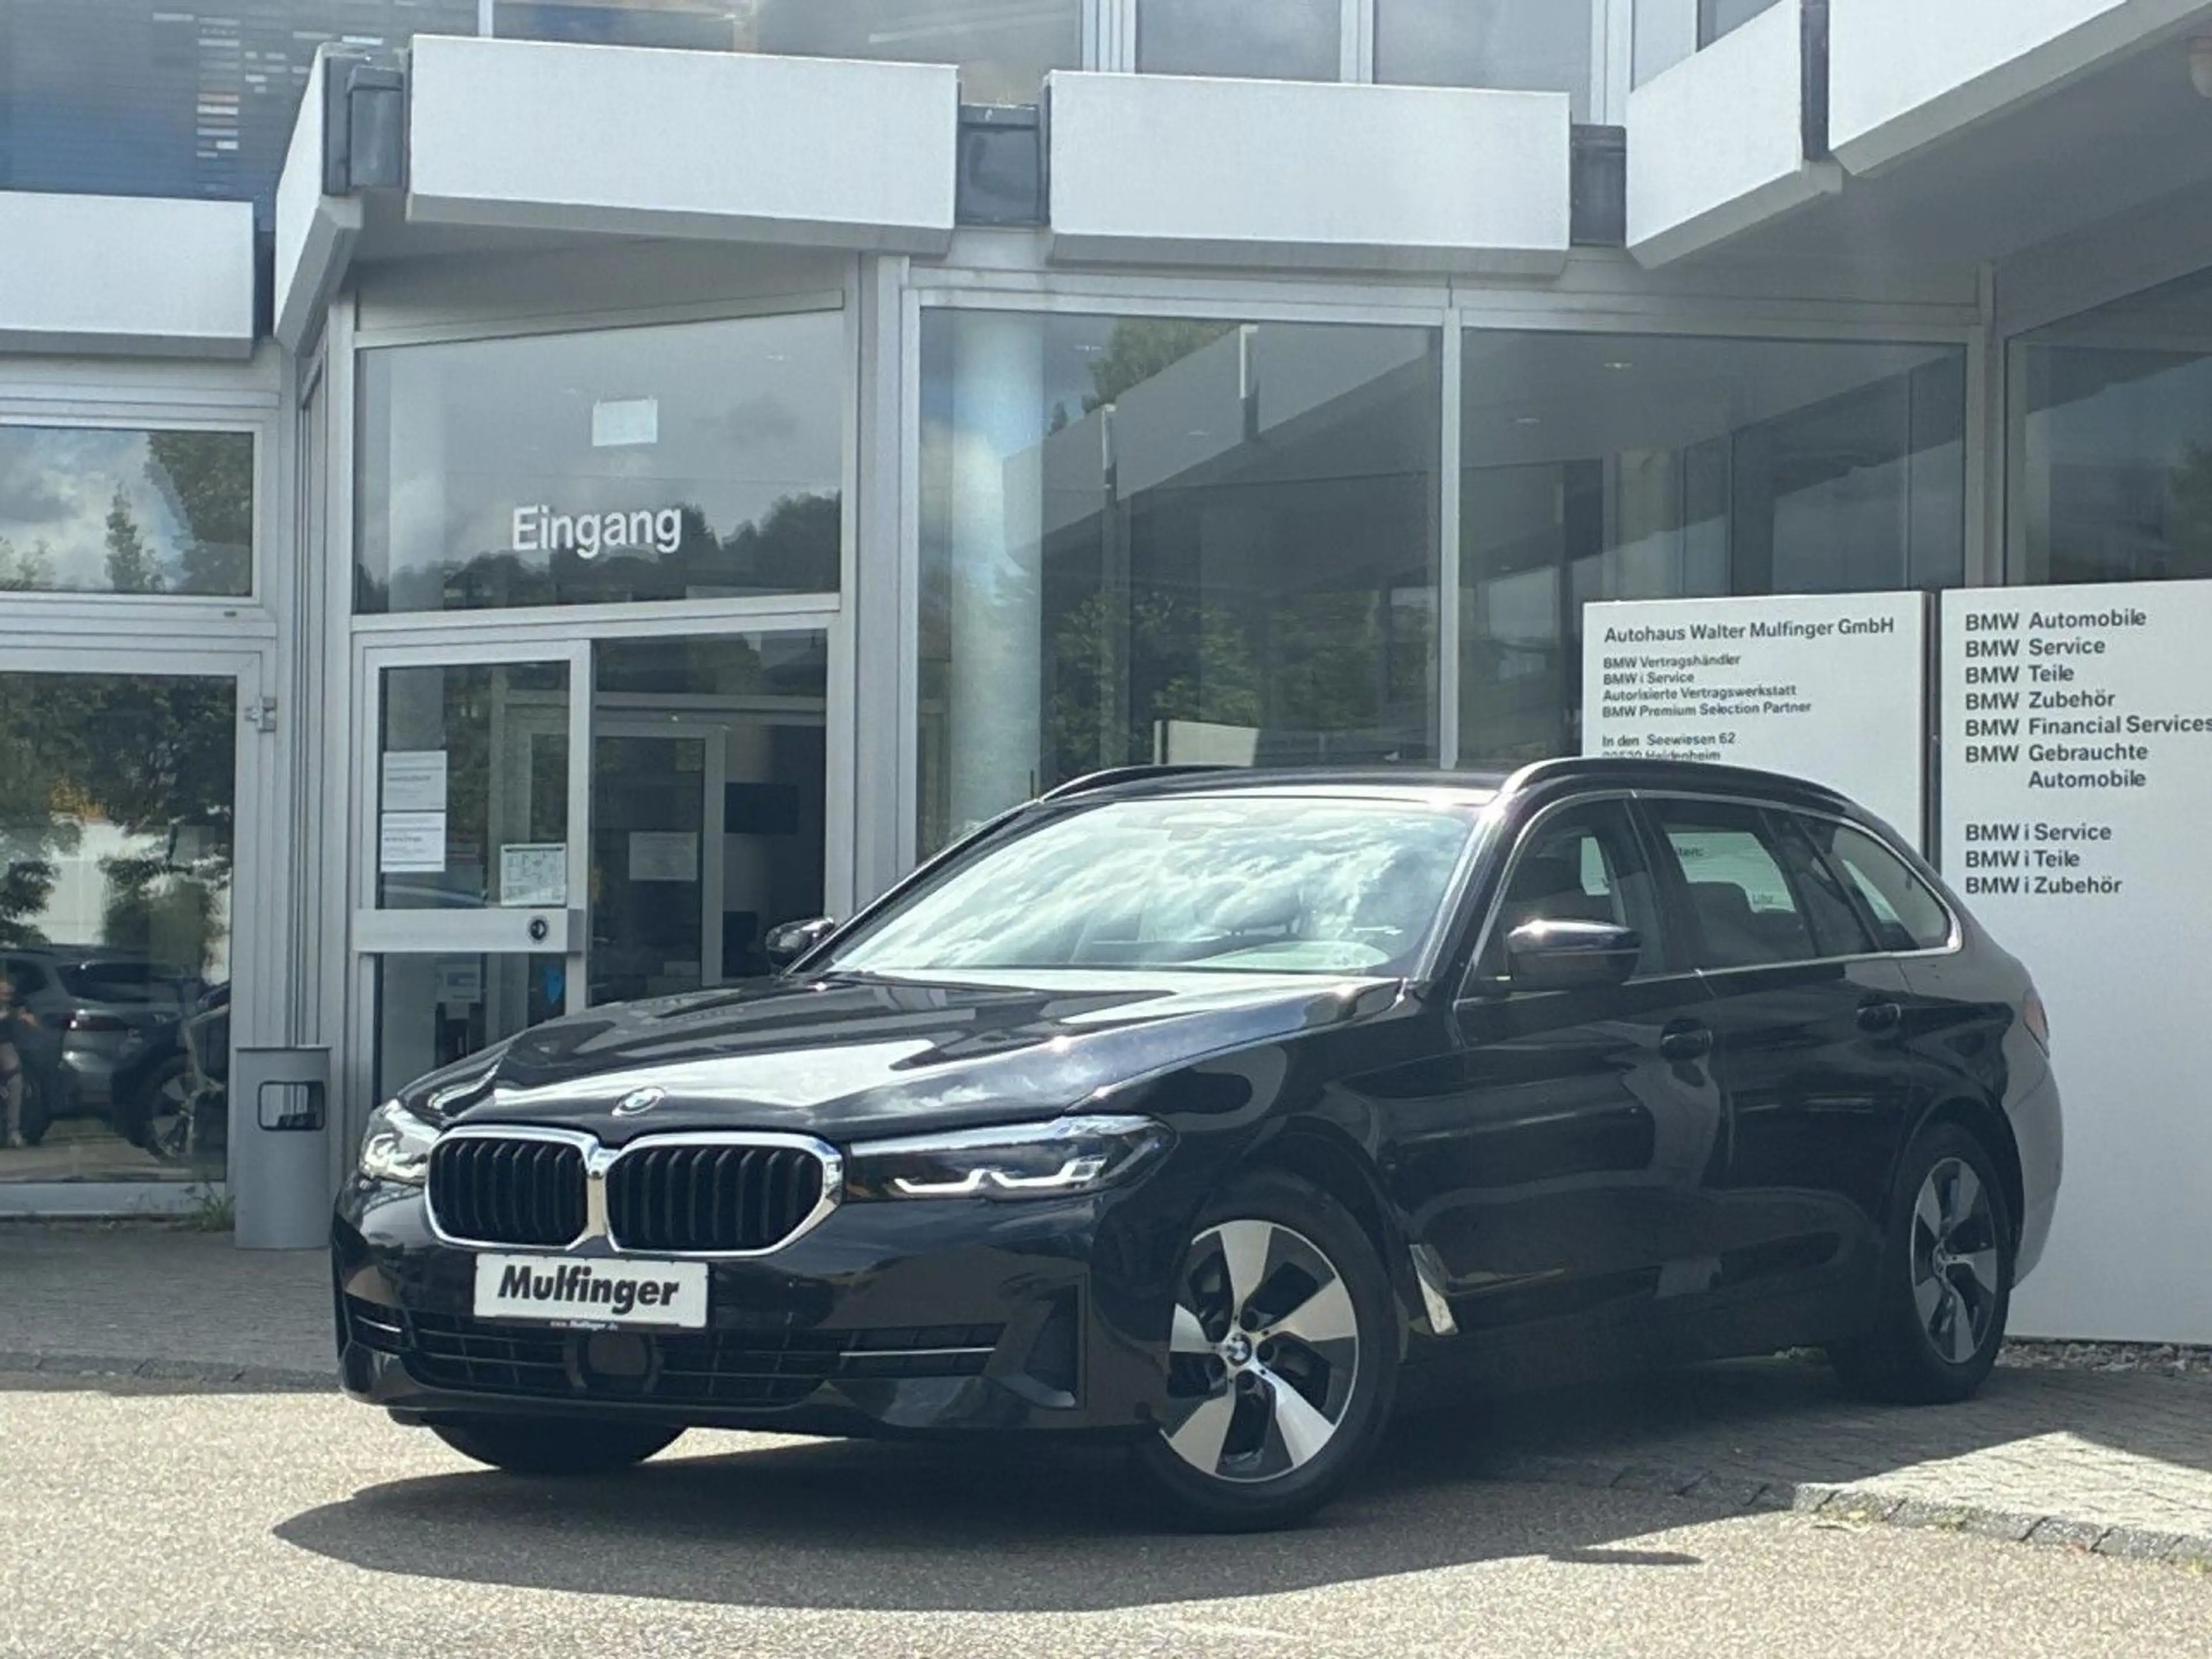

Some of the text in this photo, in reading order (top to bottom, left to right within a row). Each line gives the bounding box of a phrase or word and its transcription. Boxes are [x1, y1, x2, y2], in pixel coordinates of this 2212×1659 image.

[513, 505, 681, 559] Eingang
[1604, 616, 1894, 643] Autohaus Walter Mulfinger GmbH
[1965, 609, 2146, 631] BMW Automobile
[1965, 637, 2105, 657] BMW Service
[1604, 654, 1742, 669] BMW Vertragshändler
[1604, 673, 1637, 685] BMW
[1647, 671, 1695, 684] Service
[1965, 664, 2074, 684] BMW Teile
[1603, 684, 1797, 701] Autorisierte Vertragswerkstatt
[1965, 689, 2116, 710] BMW Zubehör
[1603, 700, 1812, 718] BMW Premium Selection Partner
[1965, 714, 2212, 737] BMW Financial Services
[1603, 732, 1736, 747] In den Seewiesen 62
[1965, 743, 2148, 763] BMW Gebrauchte
[2028, 769, 2146, 789] Automobile
[1965, 822, 2112, 841] BMW i Service
[1965, 850, 2080, 868] BMW i Teile
[1965, 875, 2123, 893] BMW i Zubehör
[498, 1264, 680, 1315] Mulfinger
